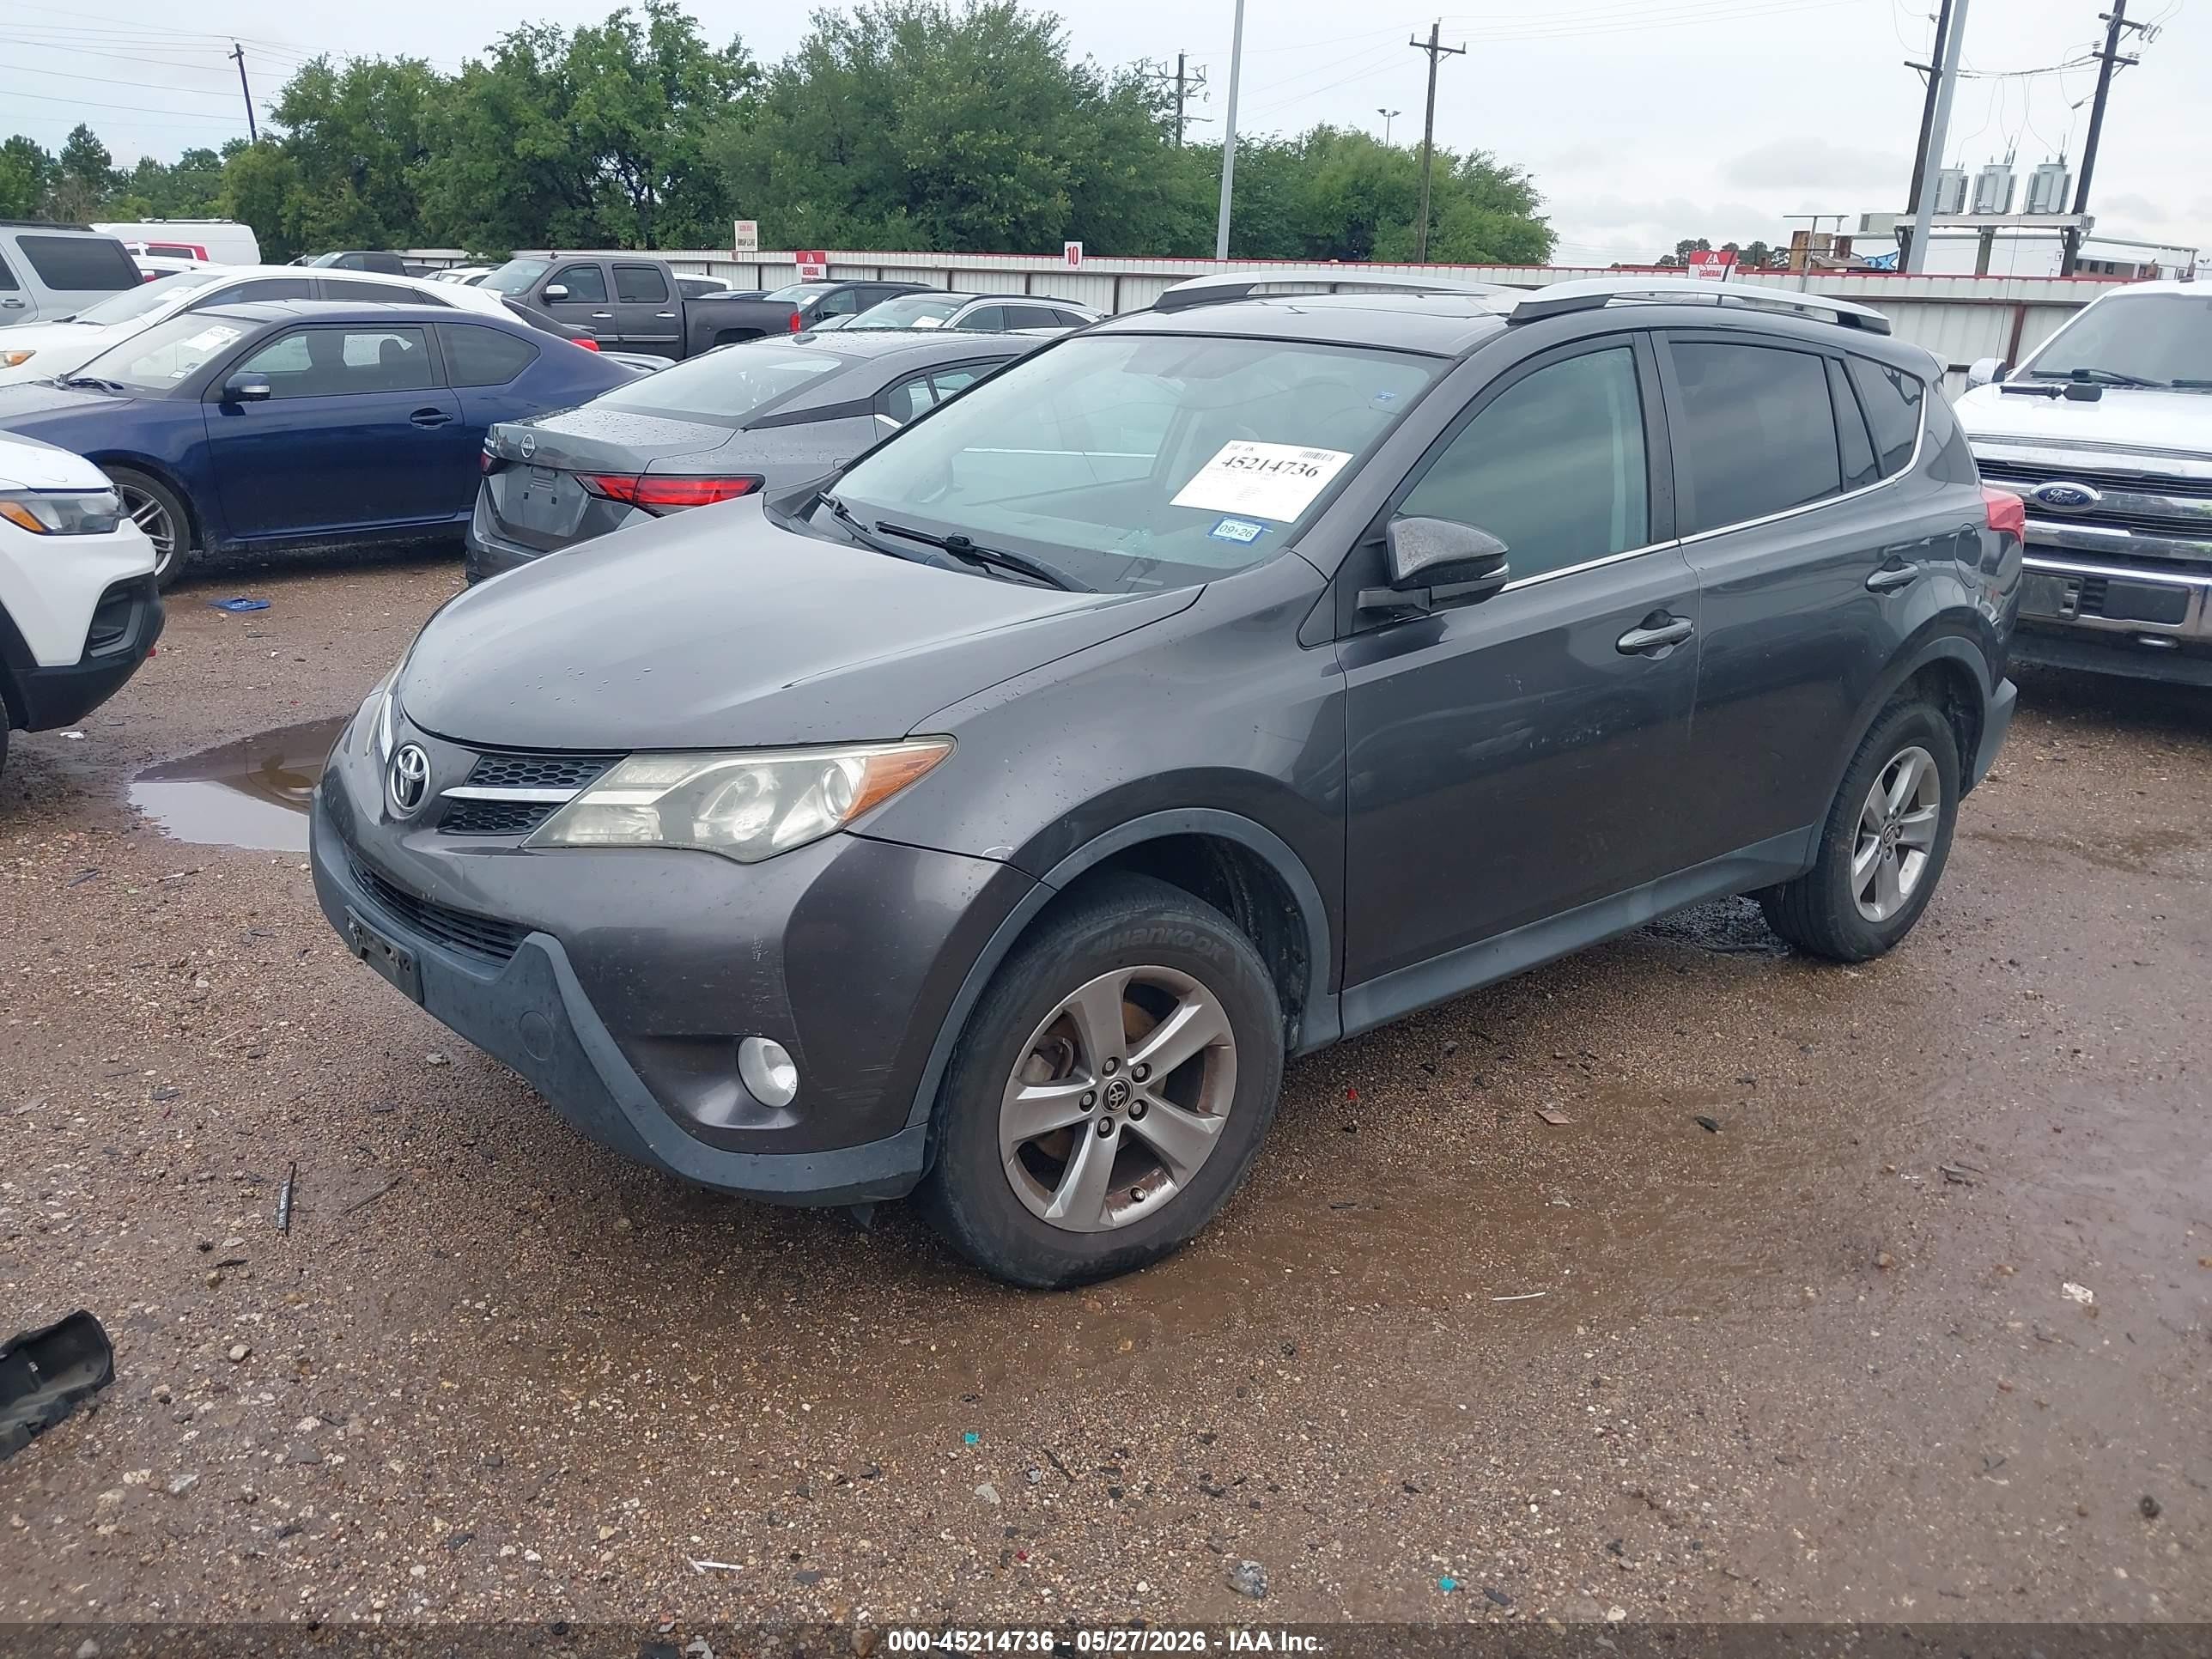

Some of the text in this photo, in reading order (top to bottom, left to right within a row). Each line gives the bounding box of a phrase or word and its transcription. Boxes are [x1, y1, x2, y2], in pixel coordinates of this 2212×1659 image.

[1066, 246, 1079, 265] 10
[1222, 456, 1323, 477] 45214736
[2045, 489, 2081, 504] Ford
